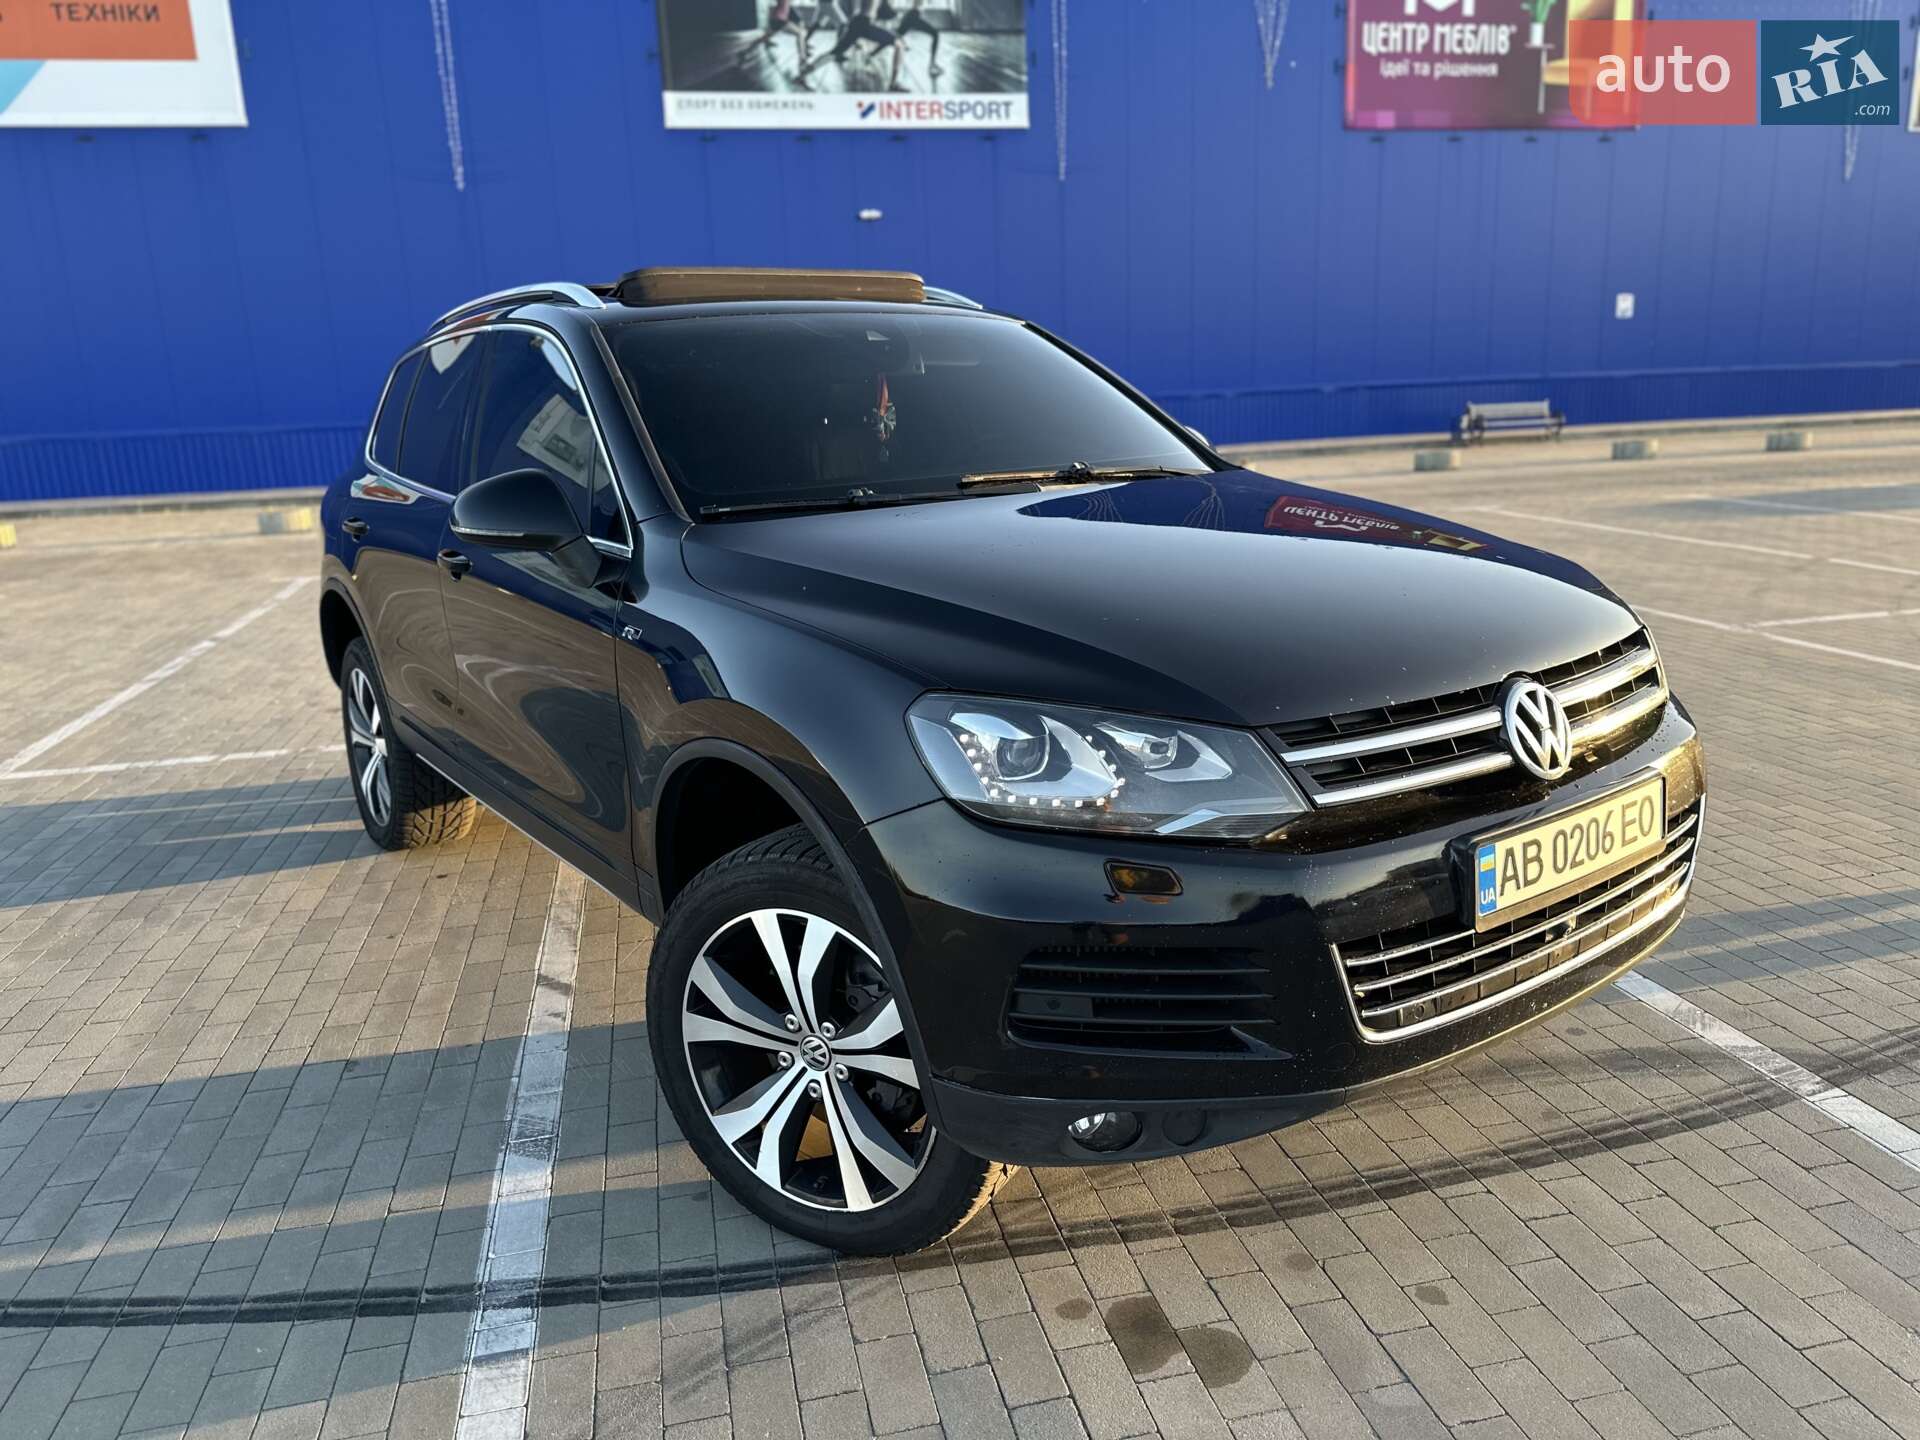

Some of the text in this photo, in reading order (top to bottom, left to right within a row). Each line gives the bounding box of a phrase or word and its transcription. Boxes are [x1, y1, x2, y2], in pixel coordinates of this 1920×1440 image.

[50, 3, 160, 22] ТЕХНІКИ
[1362, 21, 1511, 56] ЦЕНТР МЕБЛІВ
[1413, 61, 1431, 76] та
[1434, 60, 1499, 80] рішення
[878, 100, 1013, 120] INTERSPORT
[1500, 795, 1655, 897] AB 0206 EO
[1480, 889, 1496, 905] UA
